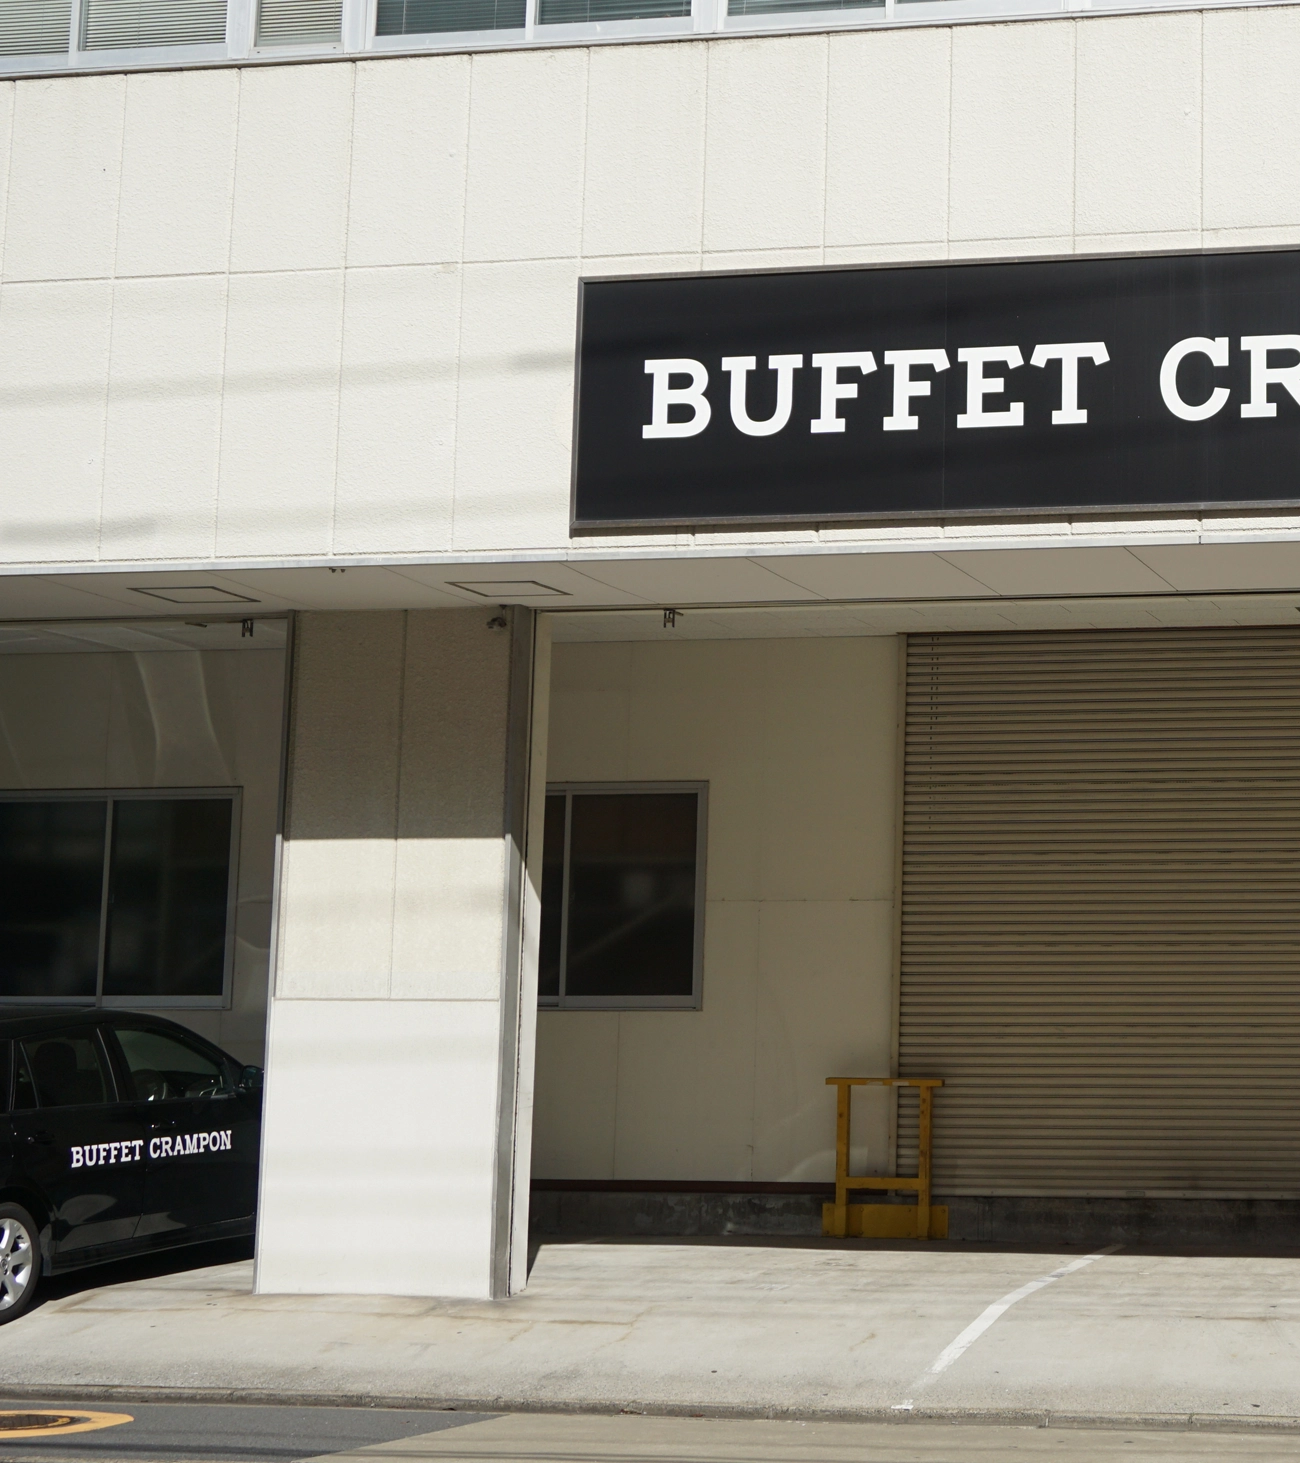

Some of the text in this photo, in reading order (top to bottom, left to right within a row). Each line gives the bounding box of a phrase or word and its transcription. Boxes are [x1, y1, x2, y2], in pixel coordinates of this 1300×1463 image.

[641, 341, 1110, 439] BUFFET
[71, 1130, 232, 1168] BUFFET CRAMPON
